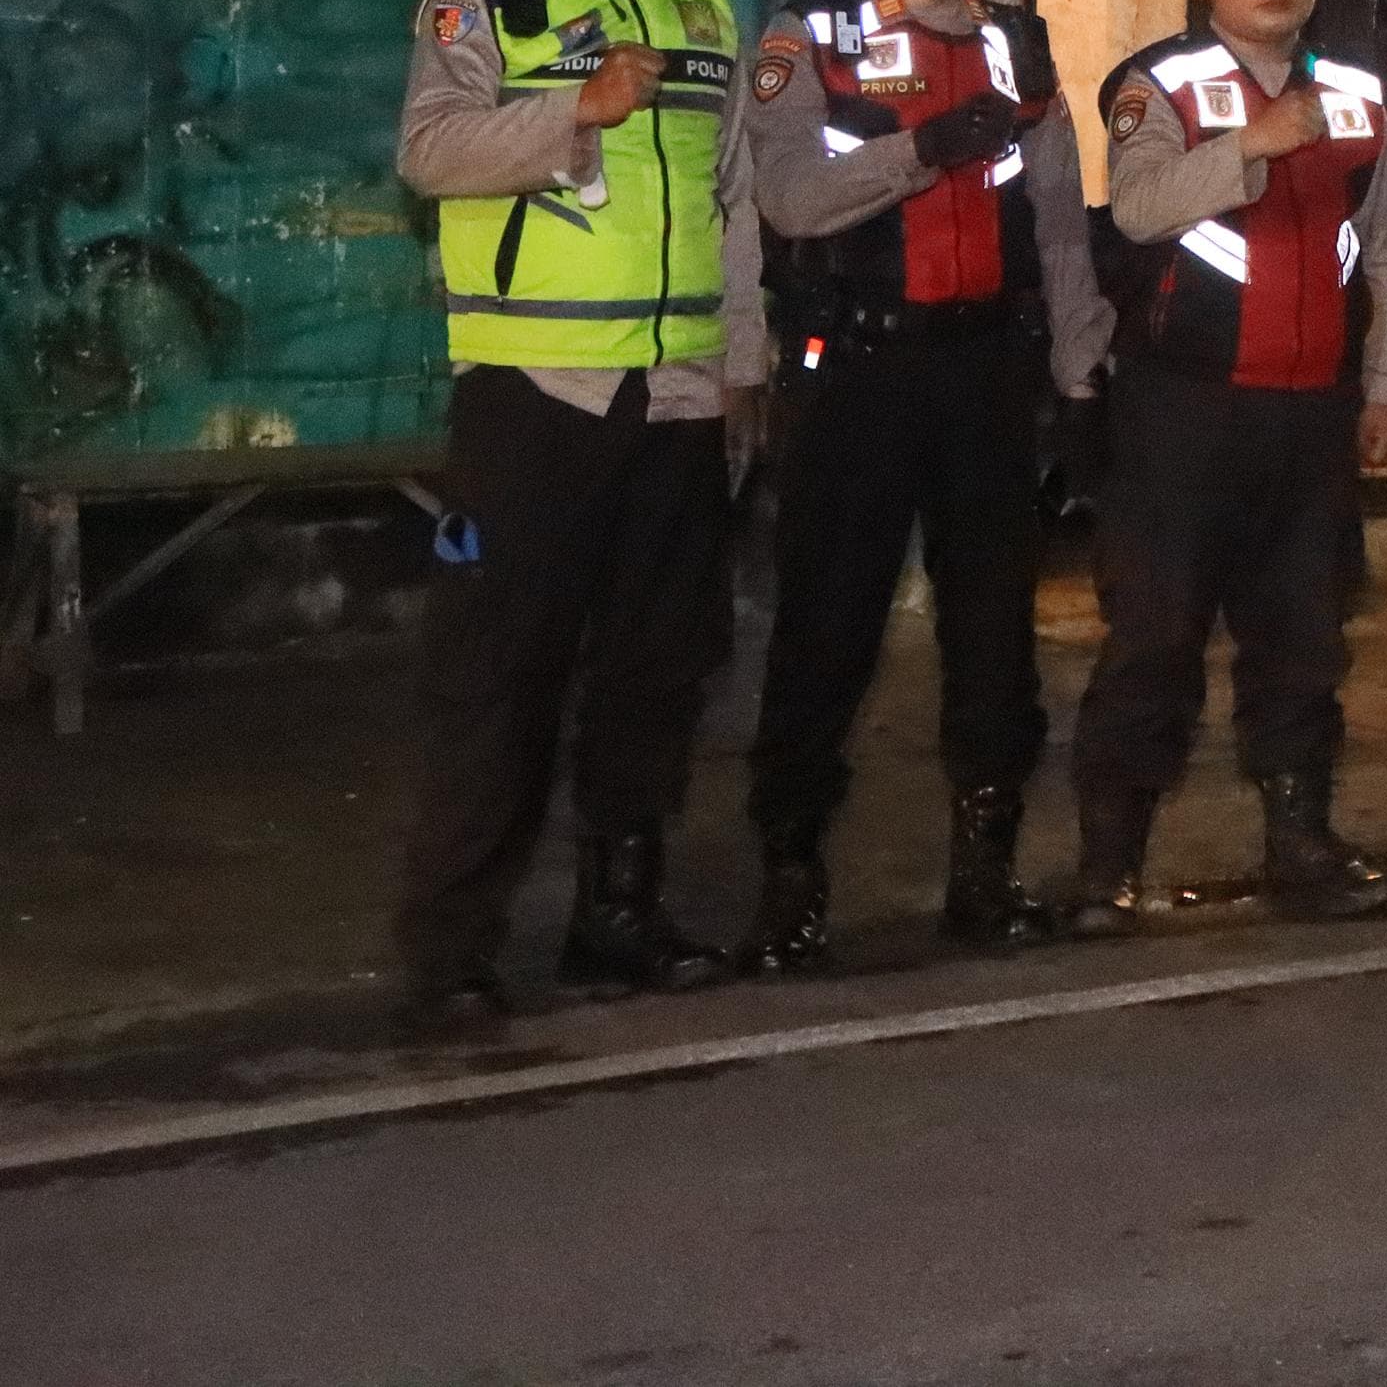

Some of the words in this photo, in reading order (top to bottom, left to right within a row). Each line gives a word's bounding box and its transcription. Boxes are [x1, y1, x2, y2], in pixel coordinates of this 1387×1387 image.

[686, 60, 729, 82] POLRI
[860, 80, 908, 94] PRIYO
[914, 80, 926, 91] H
